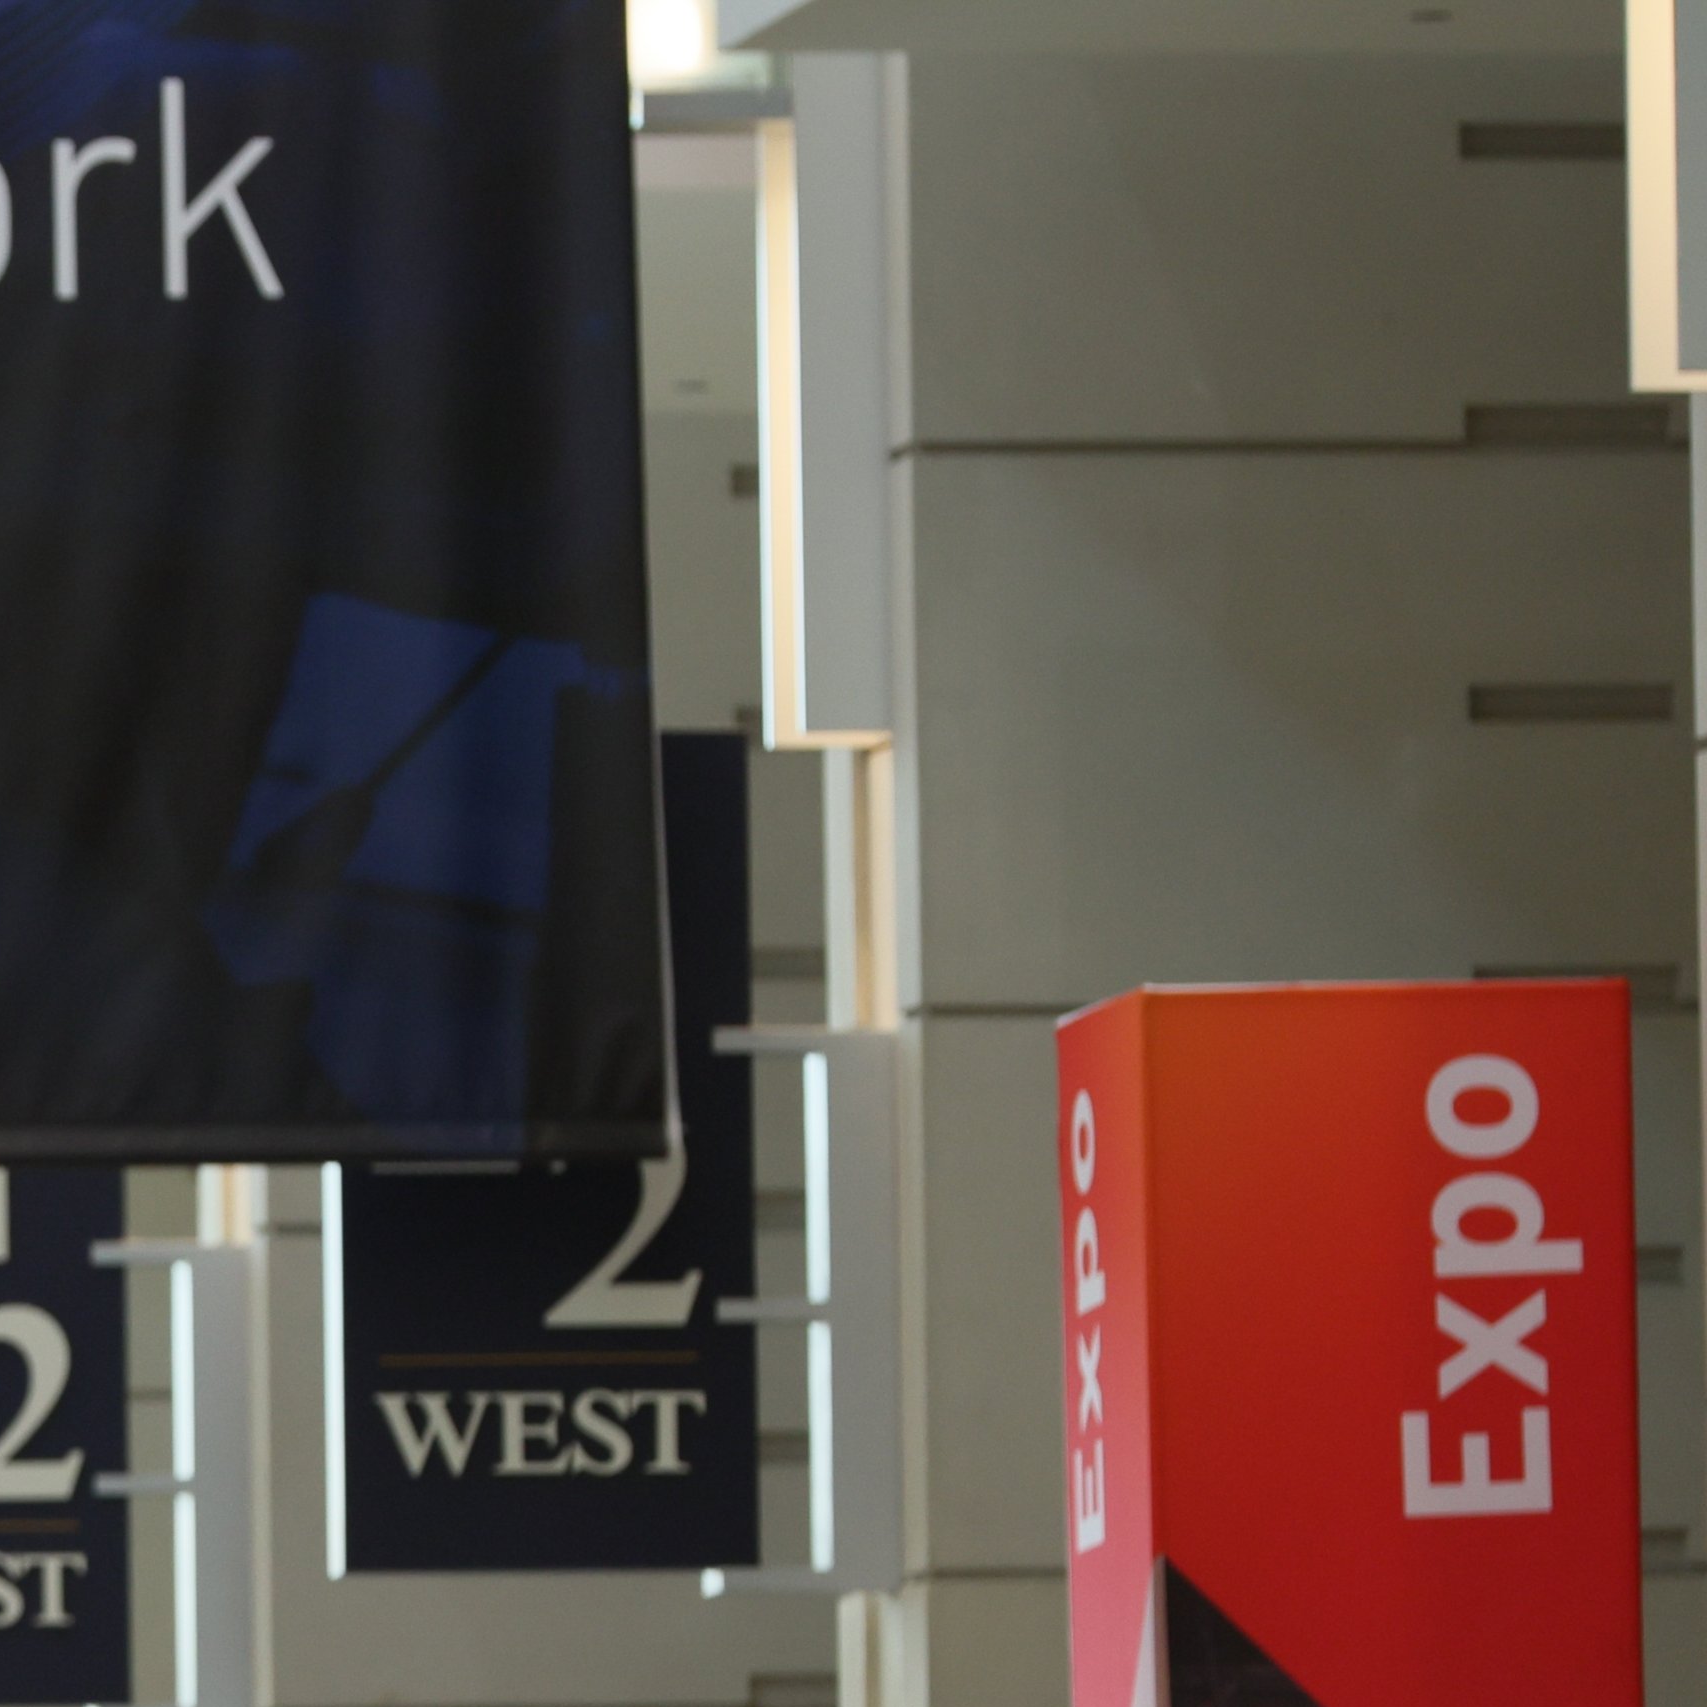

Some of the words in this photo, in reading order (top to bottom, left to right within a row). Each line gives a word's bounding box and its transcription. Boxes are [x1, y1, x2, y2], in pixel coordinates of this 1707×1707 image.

[375, 1389, 707, 1476] WEST
[1069, 1088, 1107, 1555] Expo
[1399, 1054, 1585, 1518] Expo
